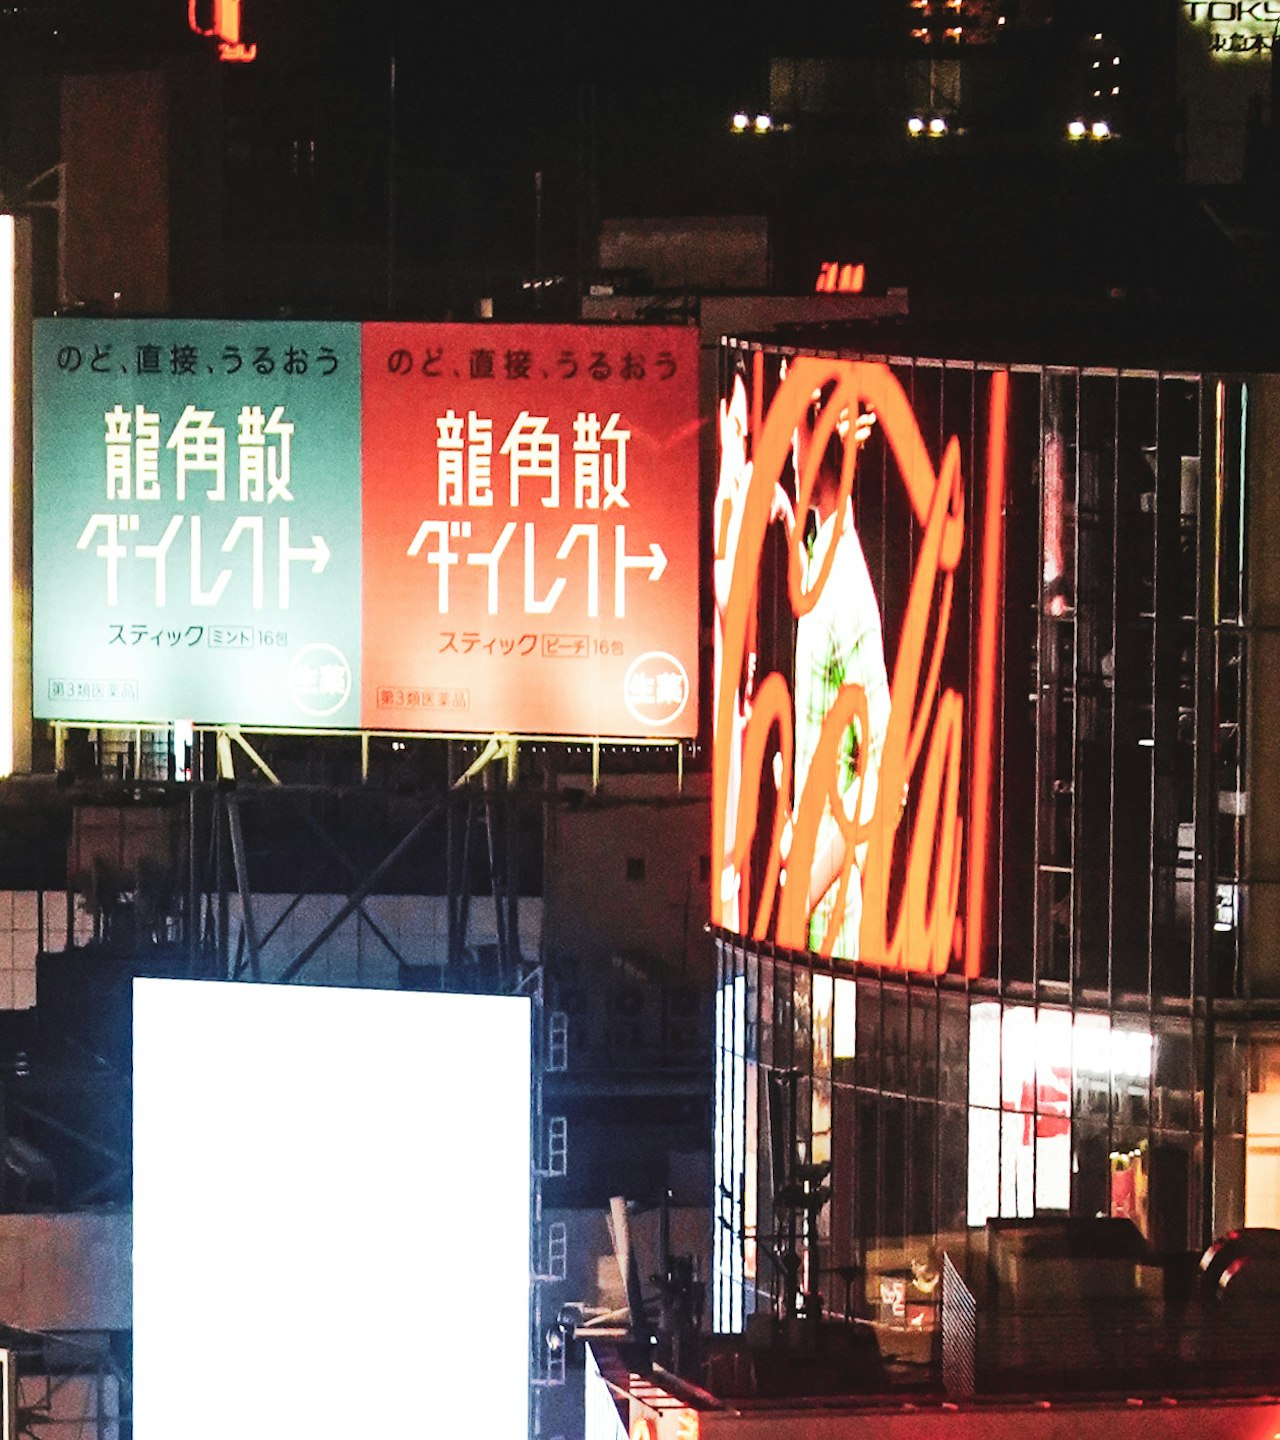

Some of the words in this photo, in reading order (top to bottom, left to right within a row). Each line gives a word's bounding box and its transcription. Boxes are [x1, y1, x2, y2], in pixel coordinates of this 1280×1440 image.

[103, 403, 296, 504] 龍角散
[435, 409, 631, 511] 龍角散
[75, 513, 332, 609] ダイレクト
[406, 519, 669, 618] ダイレクト
[108, 624, 204, 647] スティック
[439, 631, 538, 656] スティック
